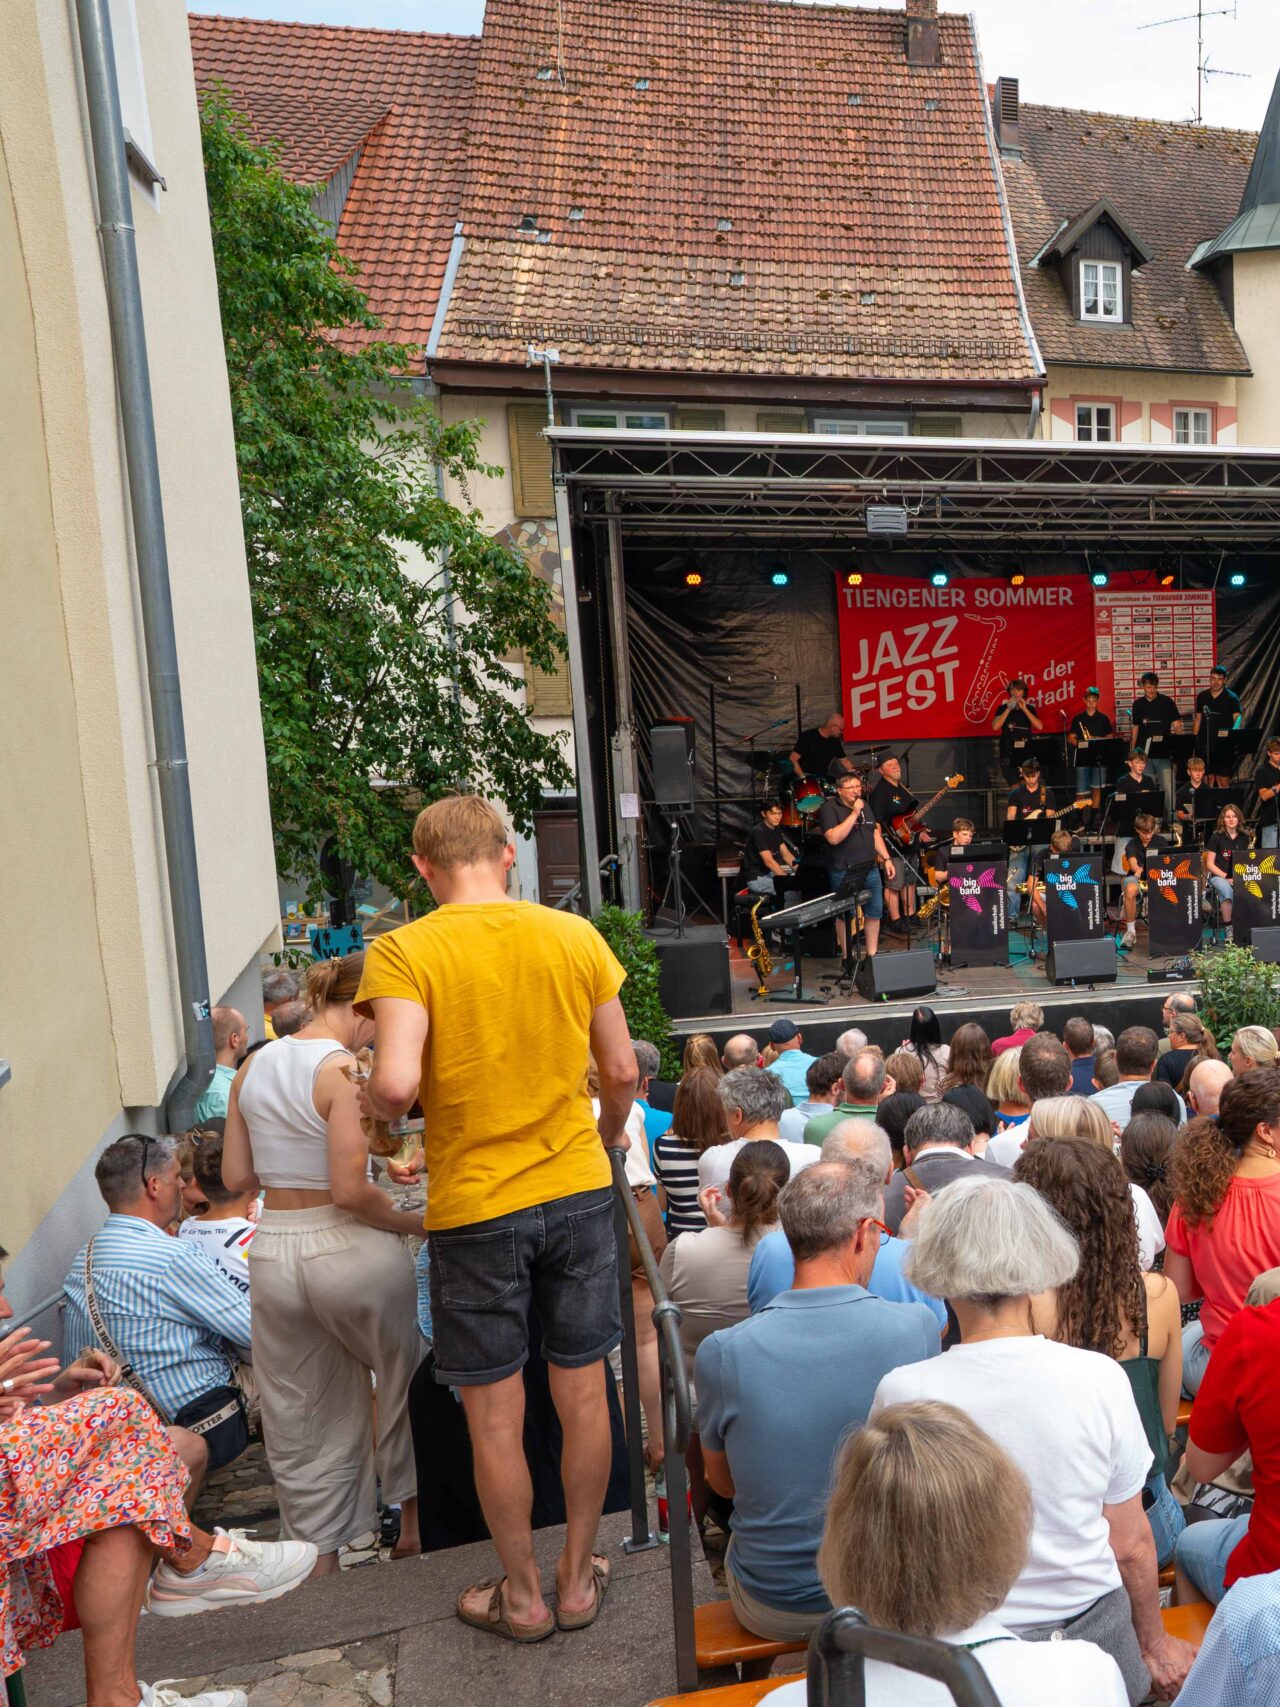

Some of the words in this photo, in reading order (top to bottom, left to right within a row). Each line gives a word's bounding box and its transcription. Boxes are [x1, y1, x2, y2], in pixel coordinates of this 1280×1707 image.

[843, 588, 966, 608] TIENGENER
[974, 587, 1074, 607] SOMMER
[852, 615, 959, 680] JAZZ
[1018, 672, 1035, 686] in
[1043, 659, 1076, 682] der
[851, 660, 960, 728] FEST
[1246, 864, 1258, 874] big
[1059, 874, 1072, 884] big
[1161, 870, 1173, 880] big
[1243, 872, 1262, 881] band
[964, 878, 976, 888] big
[1056, 882, 1076, 891] band
[1158, 878, 1176, 886] band
[960, 886, 980, 895] band
[88, 1294, 103, 1333] TROTTER
[98, 1330, 118, 1358] GLOBE
[192, 1414, 223, 1434] OTTER
